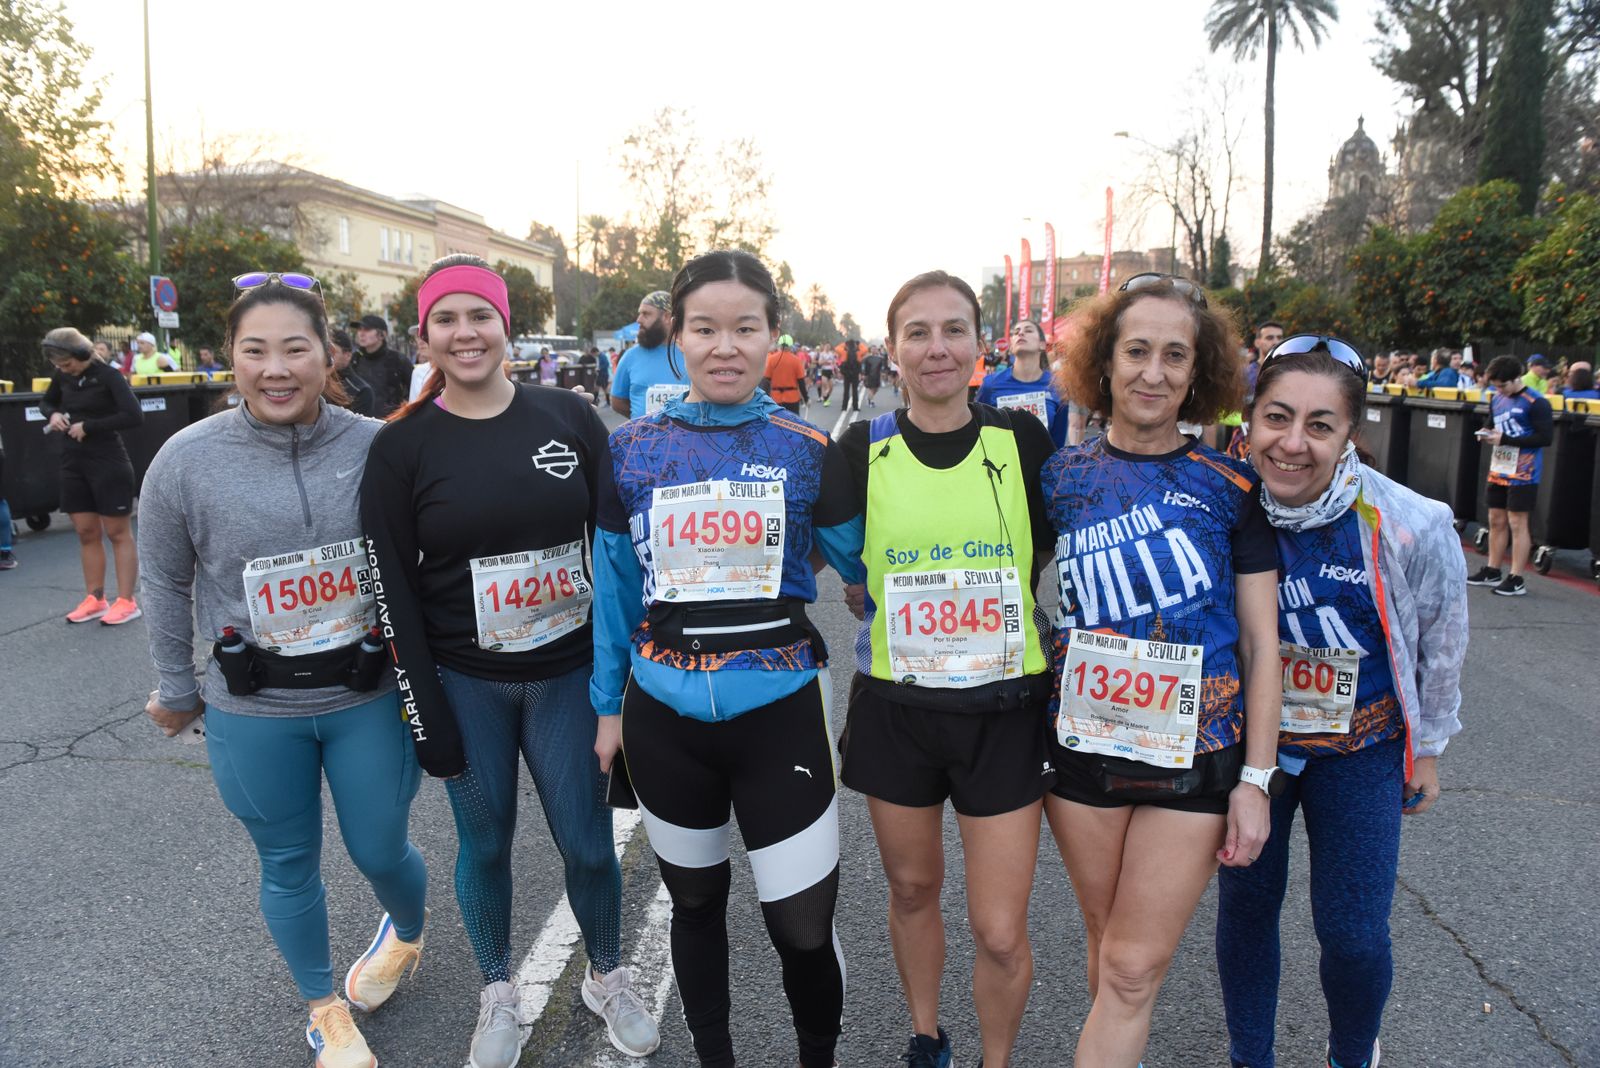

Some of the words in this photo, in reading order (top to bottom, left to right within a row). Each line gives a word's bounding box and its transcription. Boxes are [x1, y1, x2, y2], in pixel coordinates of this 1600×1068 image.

[740, 463, 787, 482] HOKA
[660, 488, 680, 501] MEDIO
[681, 483, 711, 498] MARATÓN
[729, 482, 767, 498] SEVILLA
[661, 510, 763, 548] 14599
[1075, 504, 1163, 556] MARATÓN
[250, 559, 272, 572] MEDIO
[272, 552, 304, 567] MARATÓN
[320, 541, 356, 561] SEVILLA
[478, 558, 499, 568] MEDIO
[541, 544, 571, 561] SEVILLA
[885, 547, 919, 565] Soy
[930, 543, 953, 561] de
[962, 540, 1014, 559] Gines
[893, 576, 914, 588] MEDIO
[914, 571, 946, 587] MARATÓN
[965, 570, 1002, 586] SEVILLA
[1318, 563, 1368, 585] HOKA
[258, 566, 357, 615] 15084
[366, 538, 395, 639] DAVIDSON
[485, 567, 575, 613] 14218
[707, 586, 726, 594] HOKA
[897, 597, 1002, 636] 13845
[313, 637, 331, 647] HOKA
[532, 634, 548, 645] HOKA
[1076, 631, 1095, 646] MEDIO
[1095, 635, 1129, 652] MARATÓN
[1147, 642, 1187, 661] SEVILLA
[1300, 645, 1341, 659] SEVILLA
[947, 675, 968, 683] HOKA
[1074, 661, 1179, 711] 13297
[394, 665, 428, 743] HARLEY
[1111, 705, 1129, 714] Amor
[1113, 743, 1133, 753] HOKA
